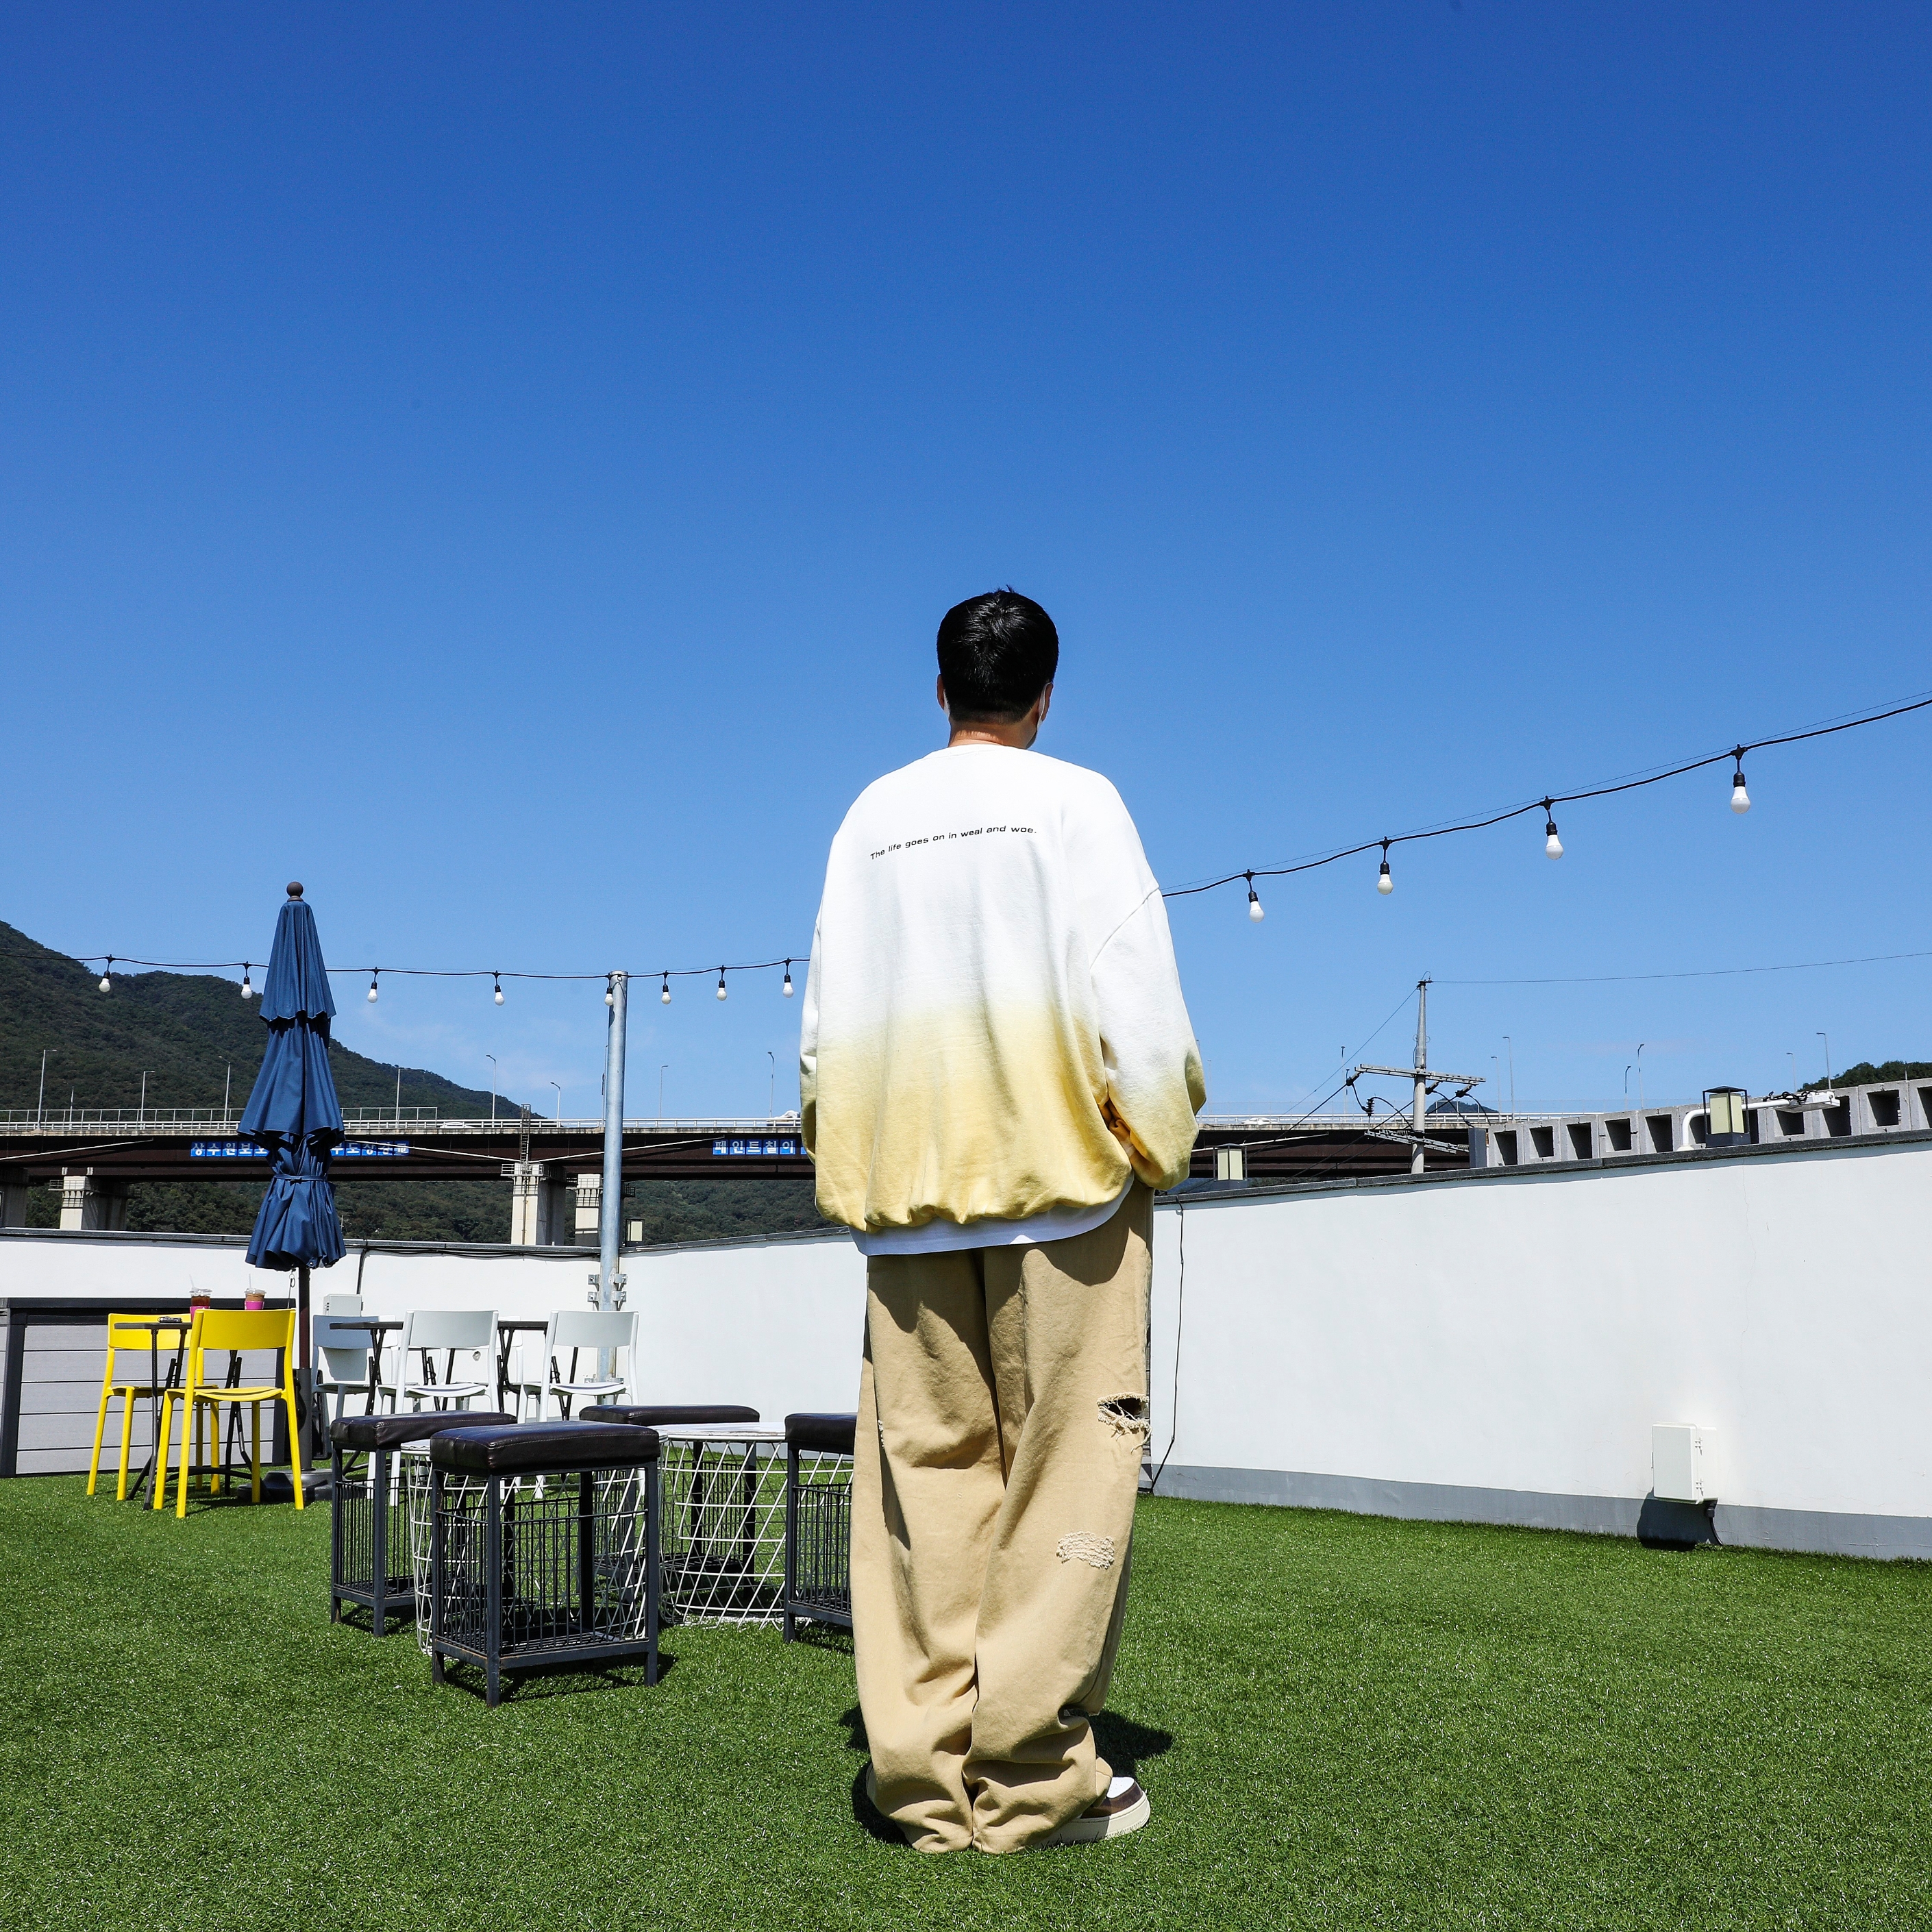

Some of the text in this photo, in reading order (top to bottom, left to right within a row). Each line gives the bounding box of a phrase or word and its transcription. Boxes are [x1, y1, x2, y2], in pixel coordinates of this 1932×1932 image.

[870, 850, 885, 860] The
[888, 843, 902, 852] life
[905, 837, 929, 848] goes
[961, 827, 983, 837] weal
[986, 825, 1006, 833] and
[715, 1140, 794, 1154] 페인트칠이
